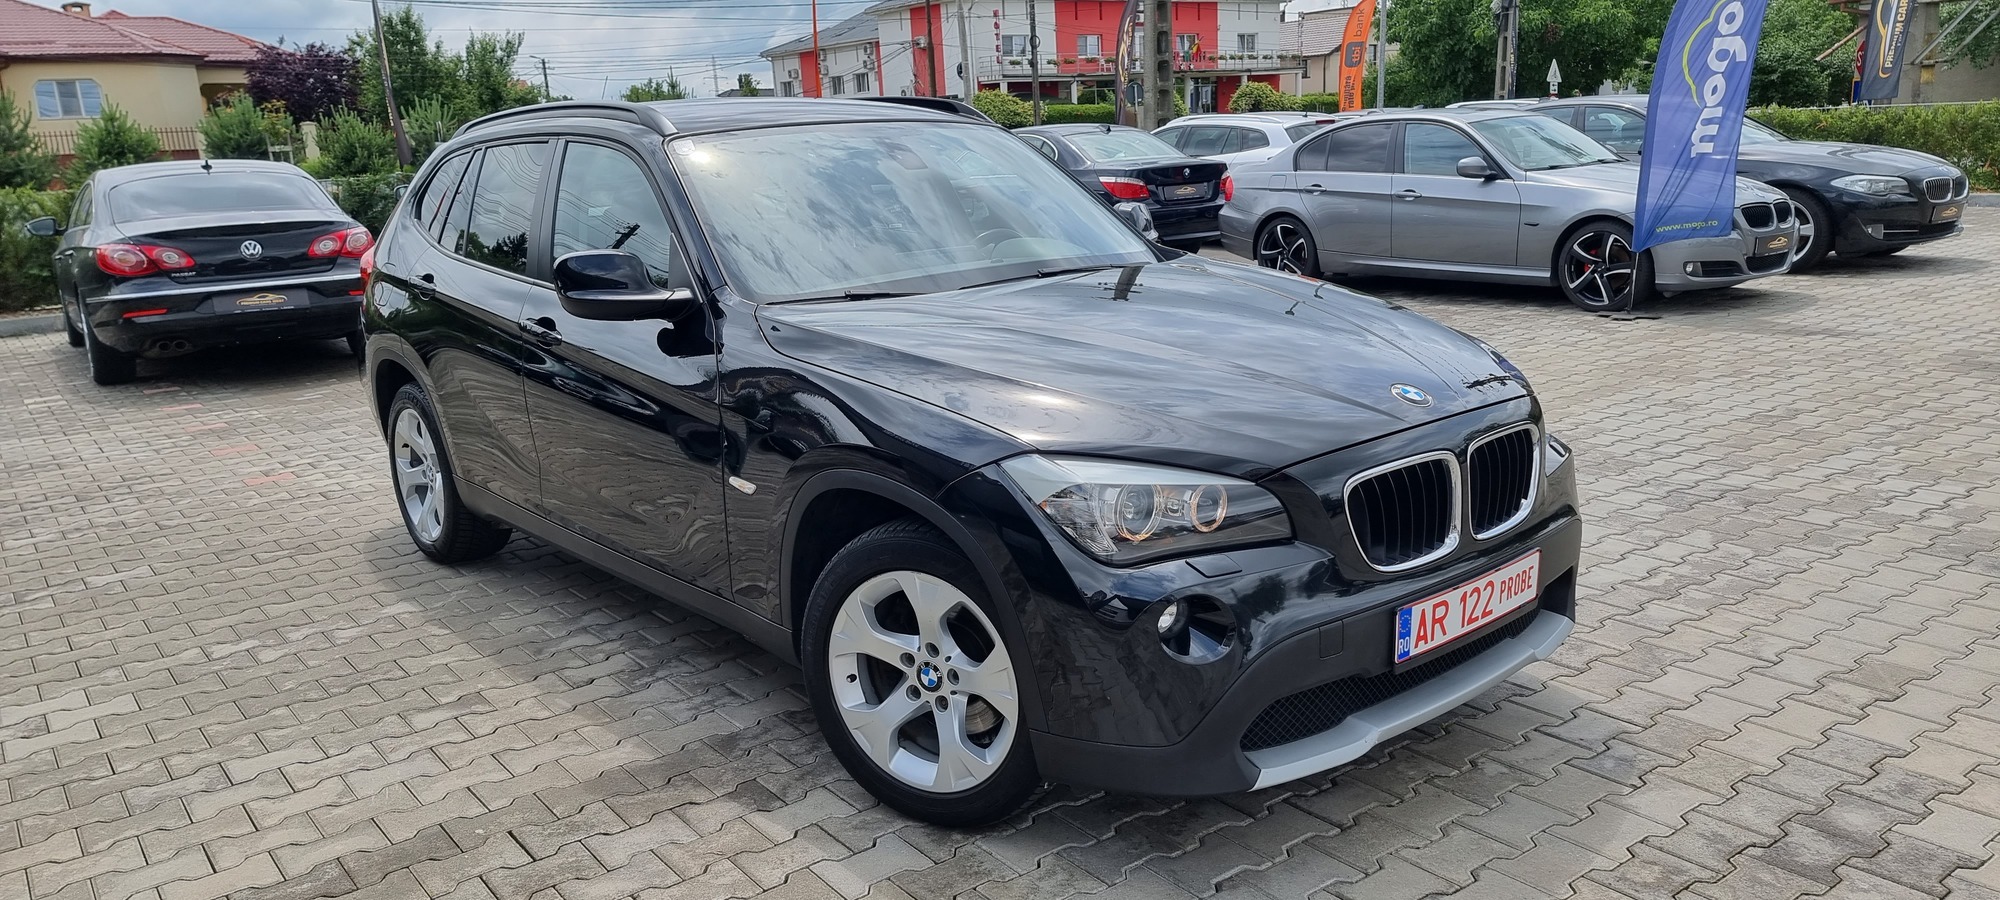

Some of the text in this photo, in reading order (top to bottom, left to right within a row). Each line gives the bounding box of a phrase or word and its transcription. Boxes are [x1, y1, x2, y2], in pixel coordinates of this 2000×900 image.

[992, 9, 1003, 65] HOTEL
[1354, 8, 1365, 37] bank
[1352, 46, 1360, 63] tbi
[1690, 1, 1747, 158] mogo
[1655, 220, 1719, 233] www.mogo.ro
[1414, 565, 1535, 649] AR 122 PROBE
[1398, 637, 1410, 655] RO
